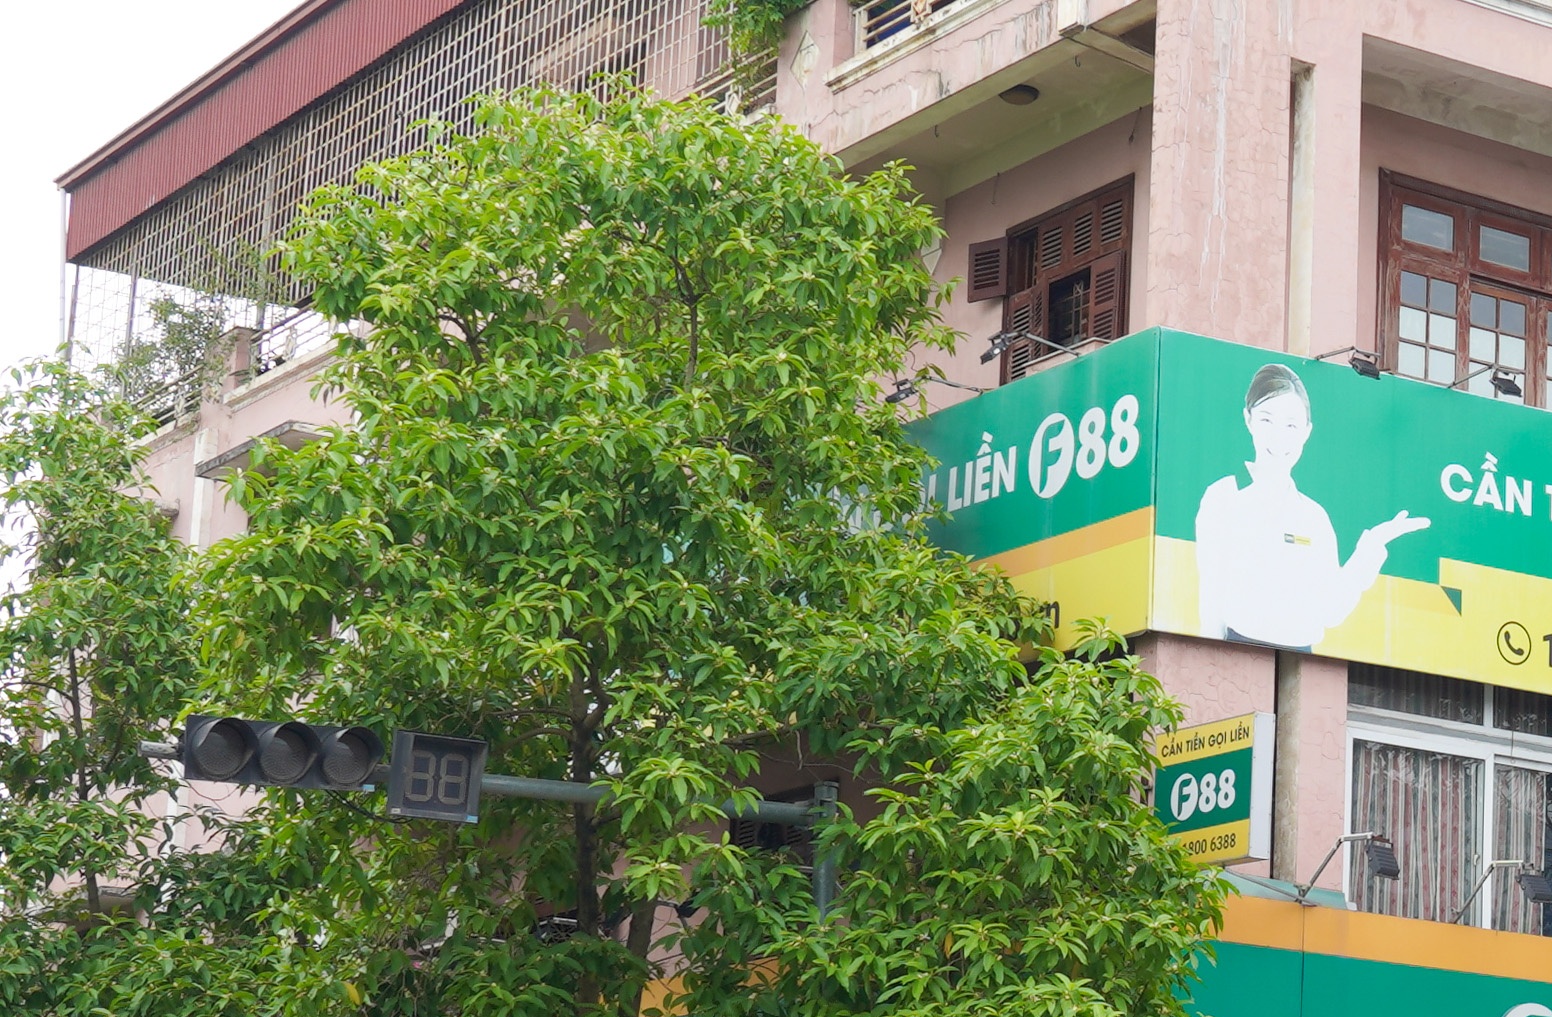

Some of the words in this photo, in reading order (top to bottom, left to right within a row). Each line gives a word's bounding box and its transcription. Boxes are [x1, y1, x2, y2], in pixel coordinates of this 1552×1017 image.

[947, 431, 1017, 512] LIỀN
[1028, 394, 1140, 499] F88
[1440, 451, 1533, 517] CẦN
[1208, 730, 1227, 749] GỌI
[1170, 768, 1236, 822] F88
[1210, 833, 1236, 852] 6388
